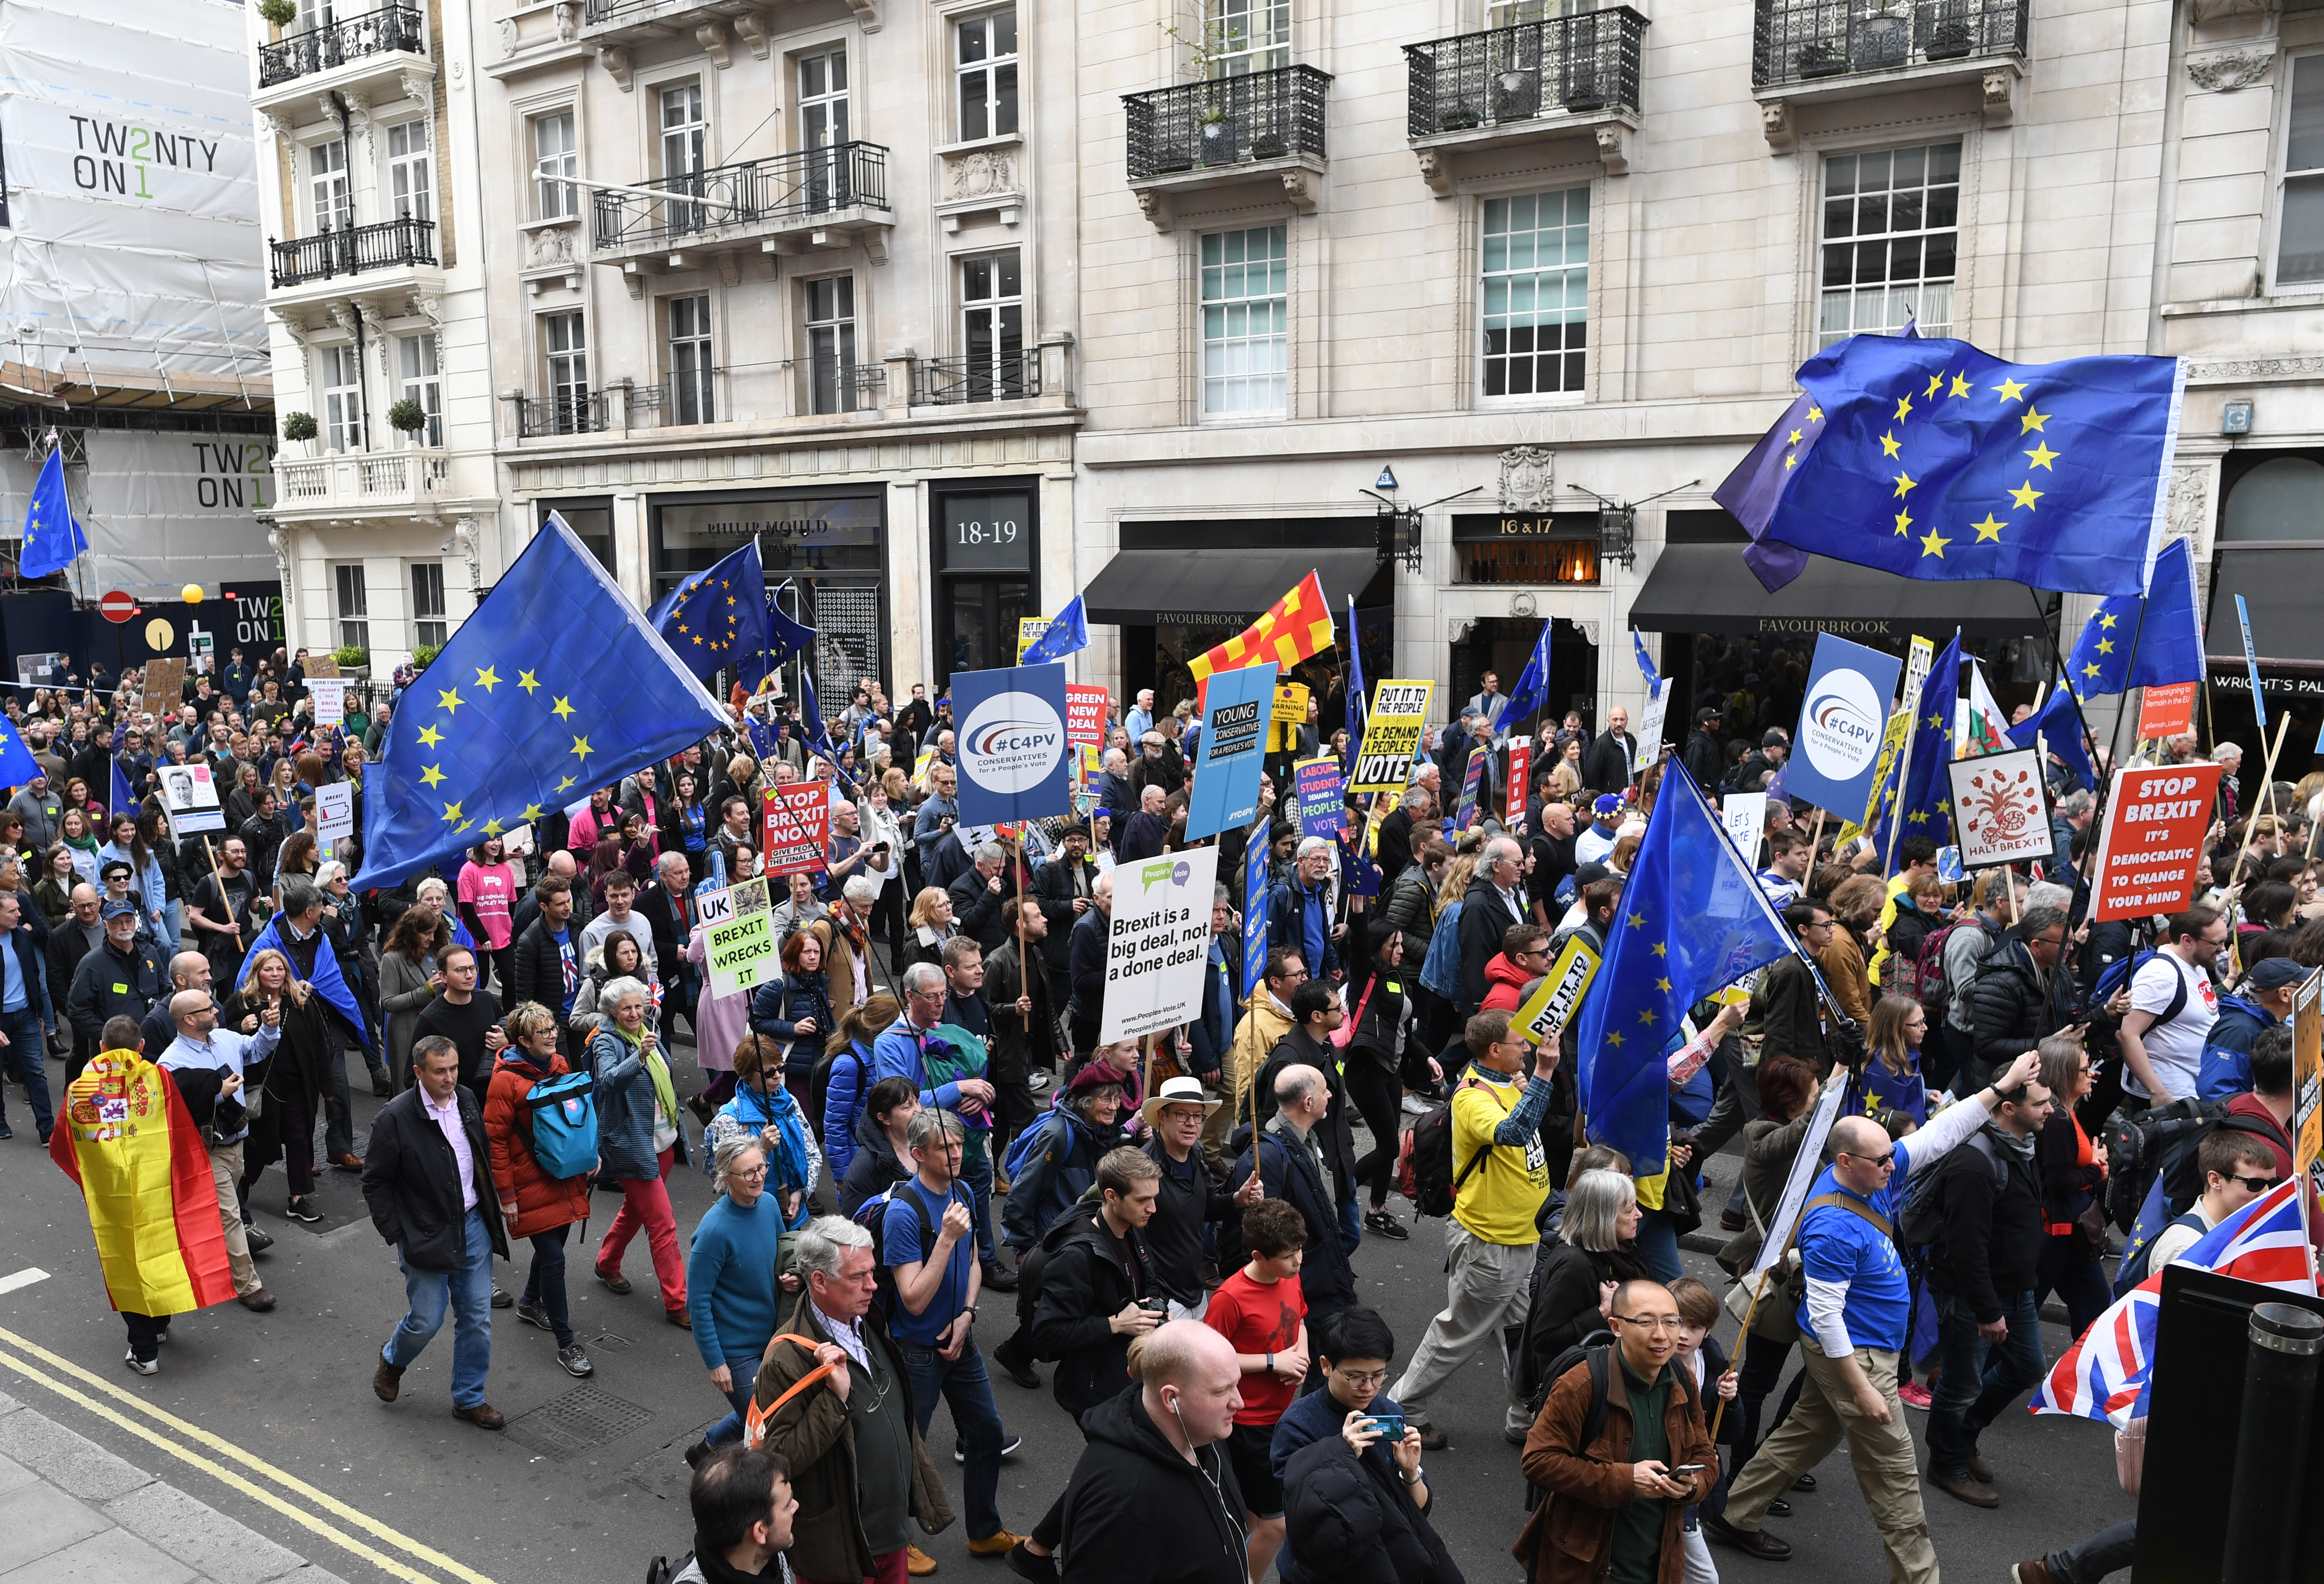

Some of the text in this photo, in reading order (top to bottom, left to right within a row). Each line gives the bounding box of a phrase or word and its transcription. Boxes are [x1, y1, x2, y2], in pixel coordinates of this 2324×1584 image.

[69, 115, 217, 172] TW2NTY
[74, 155, 153, 199] ON1
[198, 478, 266, 507] ON1
[707, 519, 828, 536] PHILIP MOULD
[958, 521, 1016, 544] 18-19
[1501, 519, 1553, 534] 16 & 17
[1156, 613, 1245, 625] FAVOURBROOK
[1759, 620, 1890, 633] FAVOURBROOK
[237, 620, 284, 643] ON1
[1066, 693, 1105, 703] GREEN
[1379, 688, 1426, 701] PUT IT TO
[2148, 686, 2184, 697] Campaigning
[1070, 706, 1098, 716] NEW
[1377, 703, 1423, 713] THE PEOPLE
[2146, 699, 2166, 707] Remain
[1068, 718, 1097, 729] DEAL
[1216, 704, 1254, 725] YOUNG
[1215, 721, 1261, 740] CONSERVATIVES
[1367, 726, 1419, 739] WE DEMAND
[1829, 717, 1874, 743] #C4PV
[996, 733, 1056, 752] #C4PV
[1209, 749, 1217, 757] FOR
[1223, 741, 1244, 753] PEOPLE'S
[1245, 739, 1256, 748] VOTE
[1363, 740, 1416, 753] A PEOPLE'S
[1812, 729, 1862, 755] CONSERVATIVES
[977, 752, 1047, 766] CONSERVATIVES
[1824, 743, 1845, 757] People's
[1848, 752, 1859, 762] Vote
[998, 763, 1028, 771] People's
[1301, 763, 1334, 778] LABOUR
[1358, 755, 1412, 783] VOTE
[1300, 777, 1340, 793] STUDENTS
[2139, 777, 2196, 798] STOP
[774, 790, 819, 810] STOP
[1308, 792, 1329, 801] DEMAND
[767, 805, 826, 829] BREXIT
[1229, 806, 1254, 821] #YC4PV
[1303, 799, 1344, 818] PEOPLE'S
[1730, 806, 1749, 827] LET'S
[2125, 800, 2202, 823] BREXIT
[319, 819, 352, 831] NEVERREADY
[774, 822, 820, 844] NOW
[1313, 818, 1338, 832] VOTE
[1991, 819, 2008, 843] AGENTS
[2006, 813, 2013, 821] OF
[2145, 830, 2169, 842] IT'S
[793, 843, 820, 853] PEOPLE
[1969, 837, 2044, 856] HALT BREXIT
[786, 854, 806, 863] FINAL
[809, 850, 823, 858] SAY
[2112, 848, 2194, 866] DEMOCRATIC
[1145, 867, 1188, 878] People's Vote
[2112, 869, 2185, 887] TO CHANGE
[703, 897, 729, 920] UK
[2108, 890, 2181, 909] YOUR MIND
[1113, 908, 1189, 937] Brexit is a
[713, 918, 763, 947] BREXIT
[1111, 922, 1208, 959] big deal, not
[713, 940, 771, 968] WRECKS
[1109, 944, 1202, 981] a done deal.
[738, 968, 753, 984] IT
[1531, 955, 1584, 1036] PUT IT TO
[1562, 961, 1588, 1014] PEOPLE
[2300, 980, 2318, 1008] EDUCATION
[1121, 1001, 1186, 1024] www.Peoples-Vote.UK
[1123, 1015, 1182, 1036] #PeoplesVoteMarch
[2301, 1069, 2318, 1104] BREXIT
[2297, 1084, 2321, 1128] WRECKS IT
